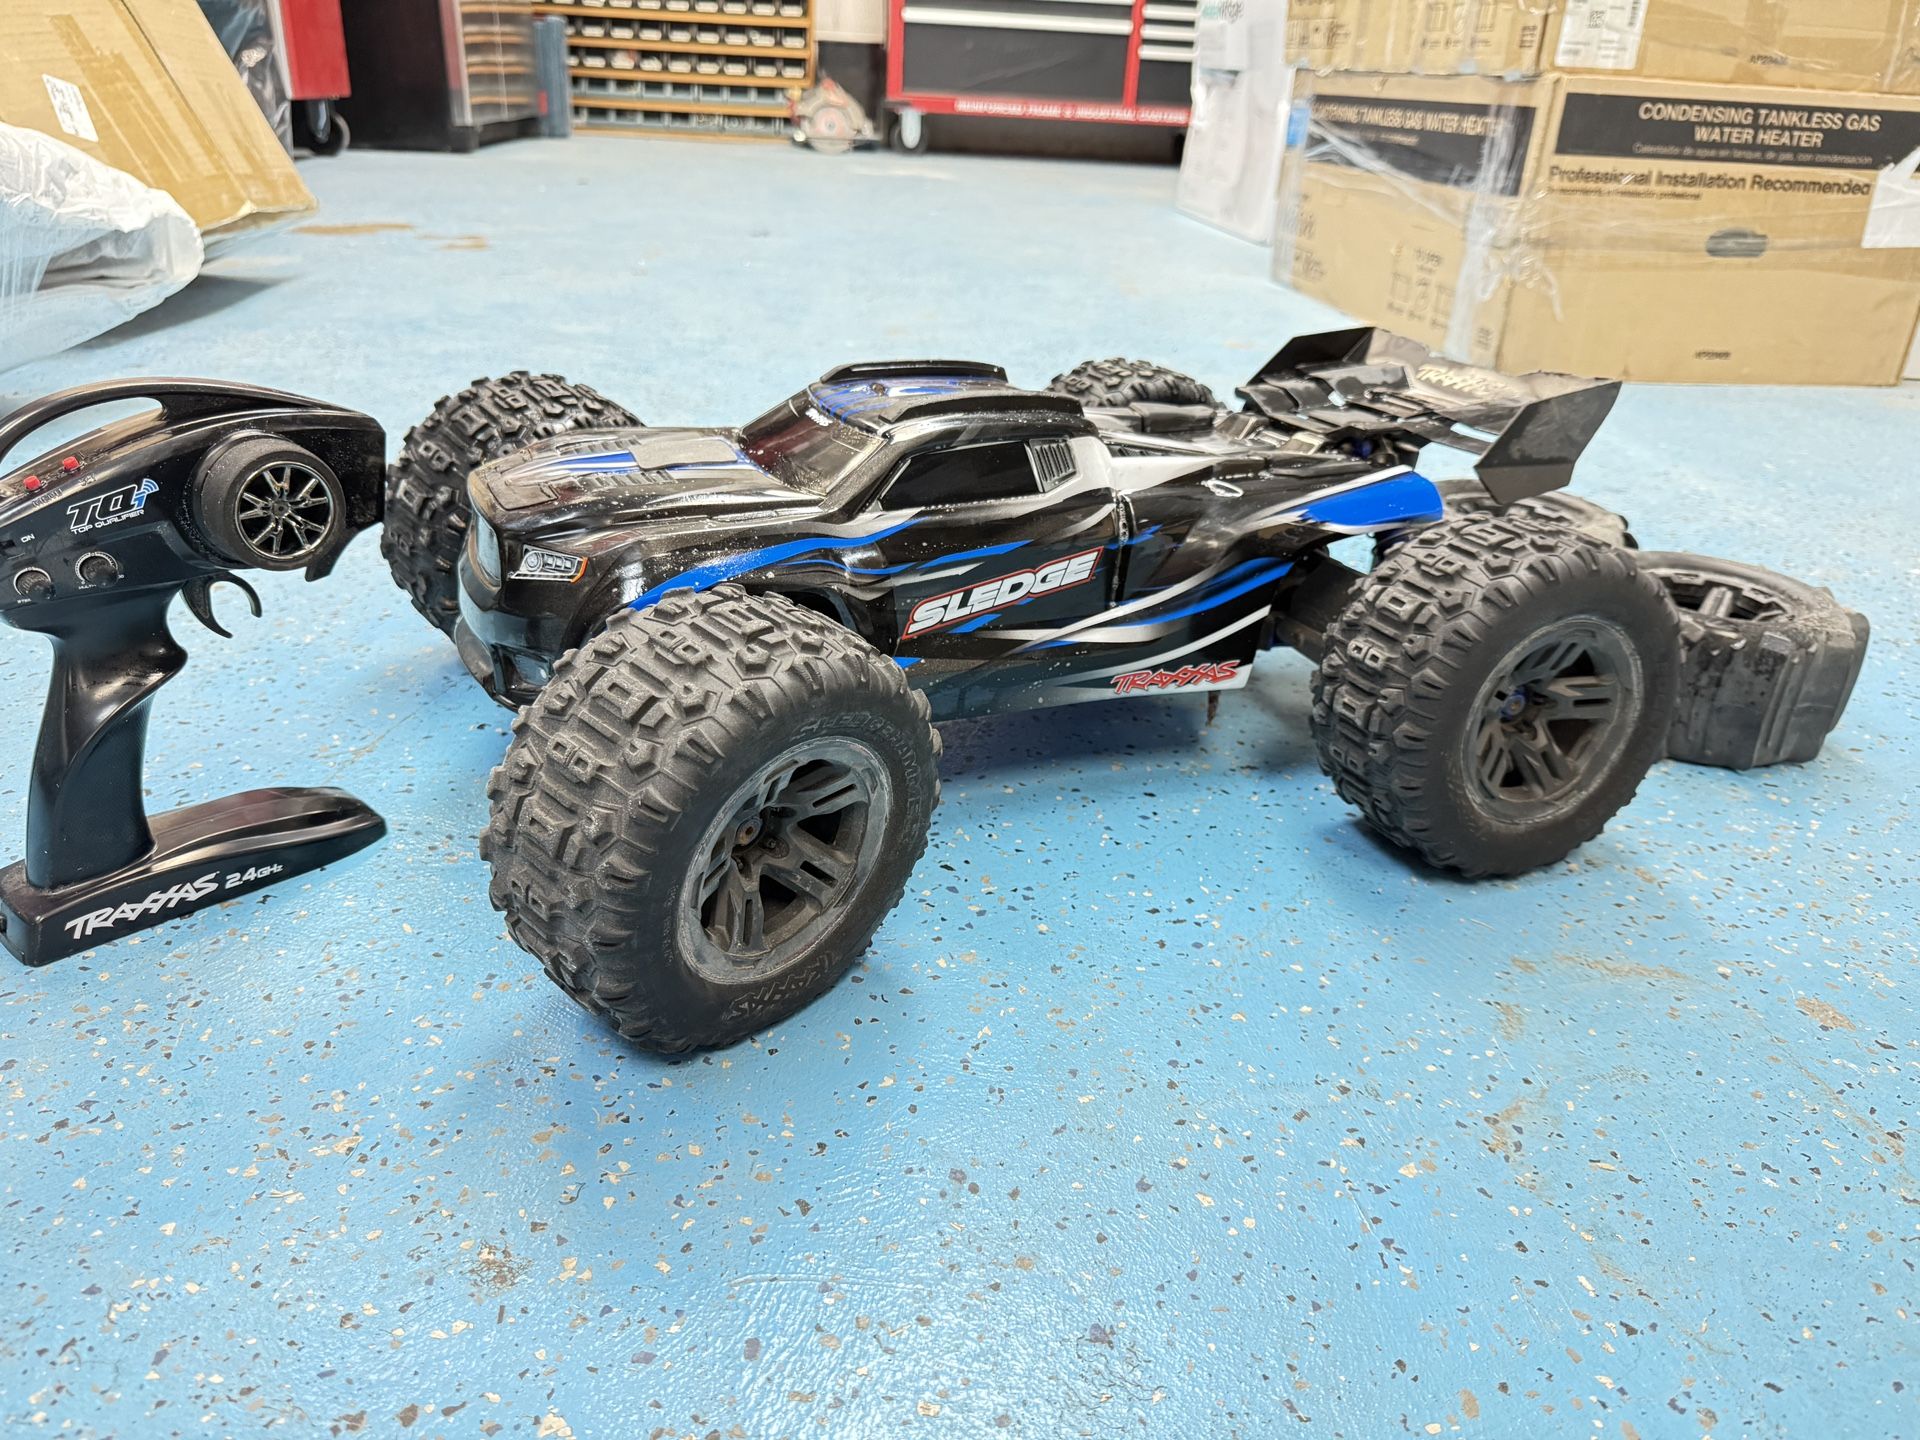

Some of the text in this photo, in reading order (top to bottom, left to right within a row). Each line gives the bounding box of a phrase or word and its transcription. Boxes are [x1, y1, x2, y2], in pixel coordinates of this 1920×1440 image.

[1638, 101, 1882, 132] CONDENSING TANKLESS GAS
[1694, 125, 1824, 148] WATER HEATER
[1654, 171, 1747, 191] Installation
[71, 509, 145, 535] TOP QUALIFIER
[20, 533, 36, 543] ON
[908, 551, 1100, 634] SLEDGE
[1111, 659, 1242, 695] TRAXXAS
[64, 863, 284, 940] TRAXXAS 2.4GHz
